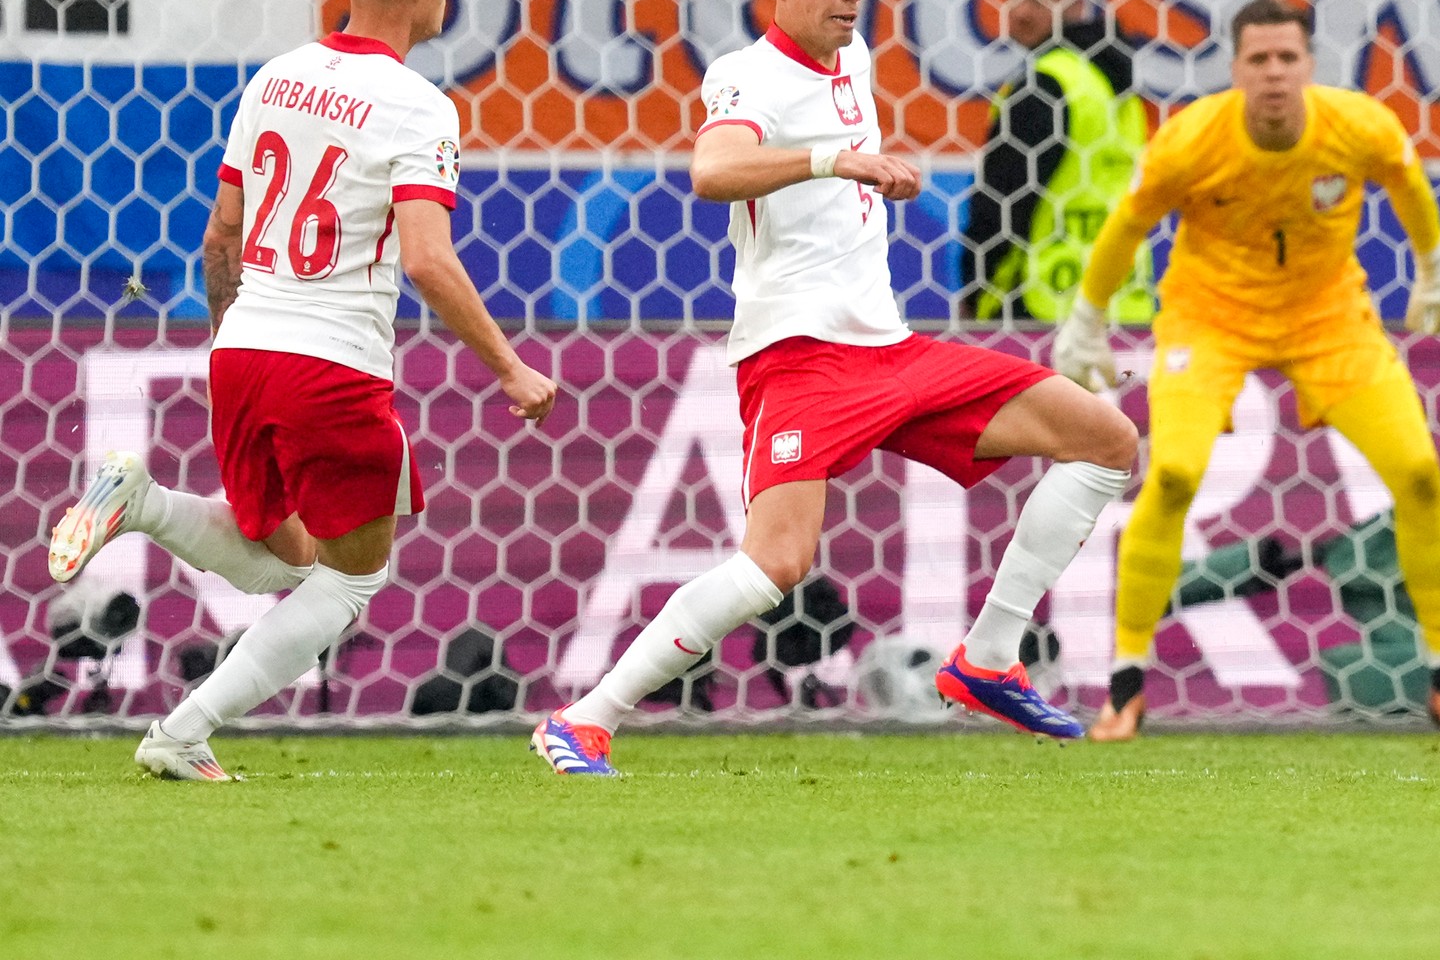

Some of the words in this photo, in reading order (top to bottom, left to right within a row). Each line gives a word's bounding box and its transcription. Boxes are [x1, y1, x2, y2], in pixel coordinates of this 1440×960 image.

[261, 77, 373, 130] URBAŃSKI
[242, 130, 348, 280] 26
[1273, 230, 1287, 267] 1
